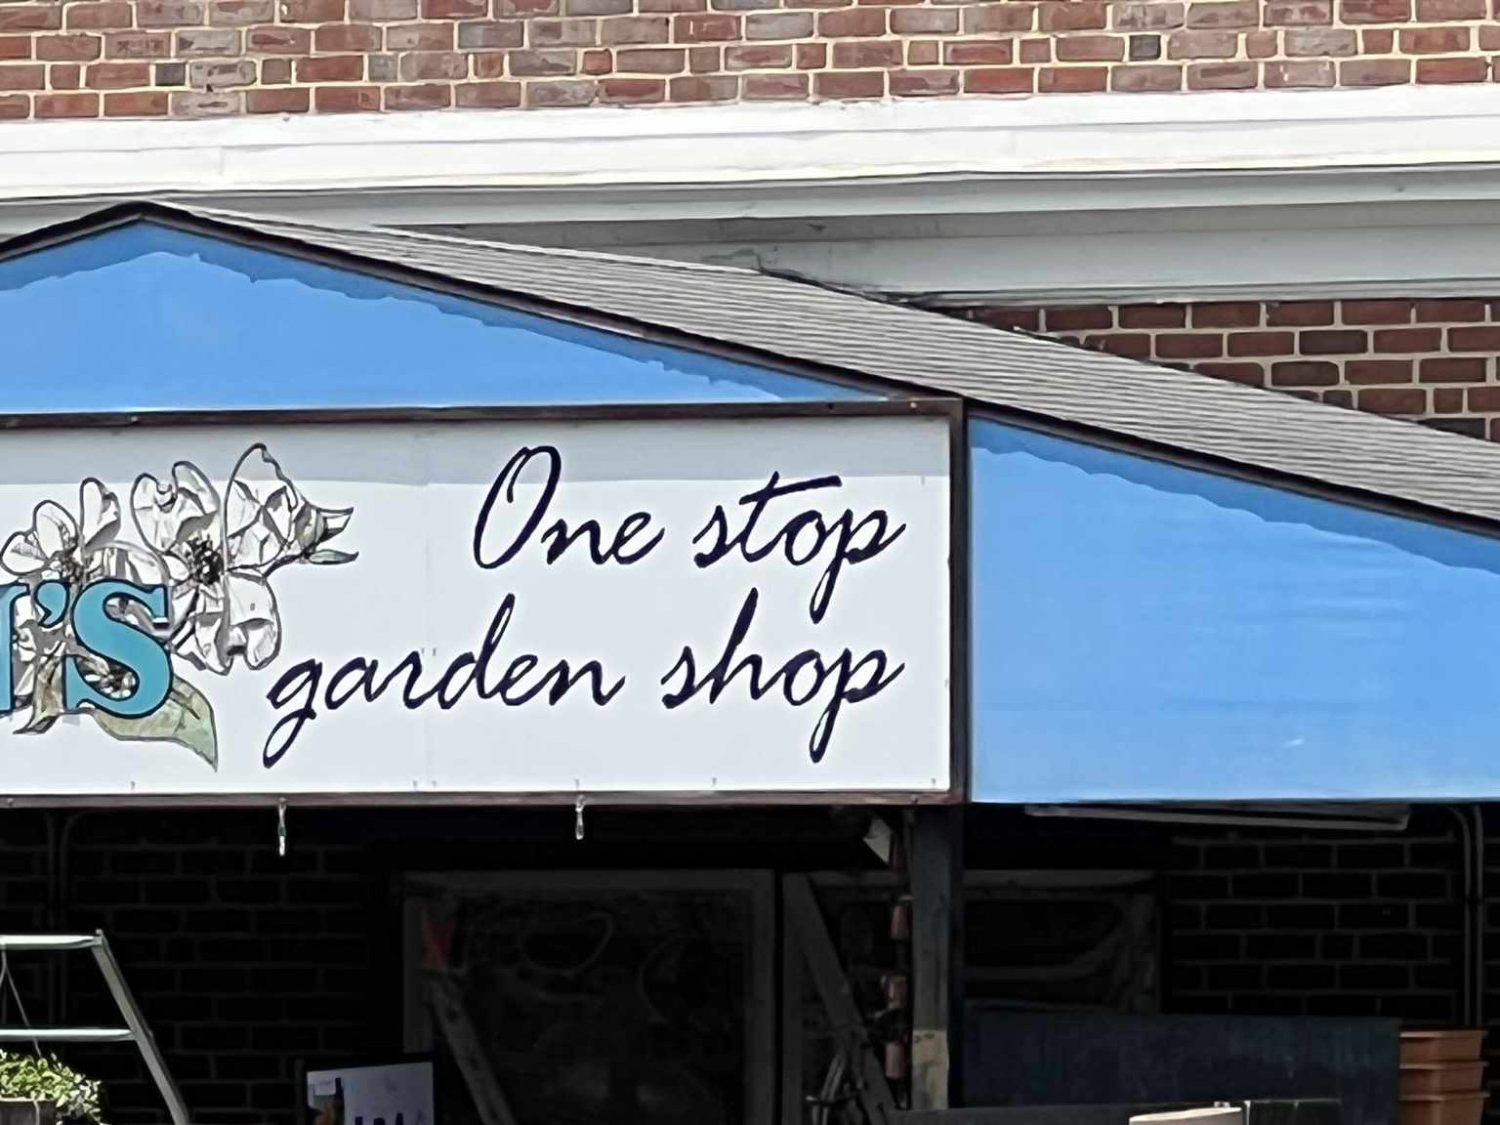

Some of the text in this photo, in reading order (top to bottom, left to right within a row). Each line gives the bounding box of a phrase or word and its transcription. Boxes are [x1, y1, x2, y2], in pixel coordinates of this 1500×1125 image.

[473, 445, 907, 625] One stop
[263, 587, 905, 769] garden shop
